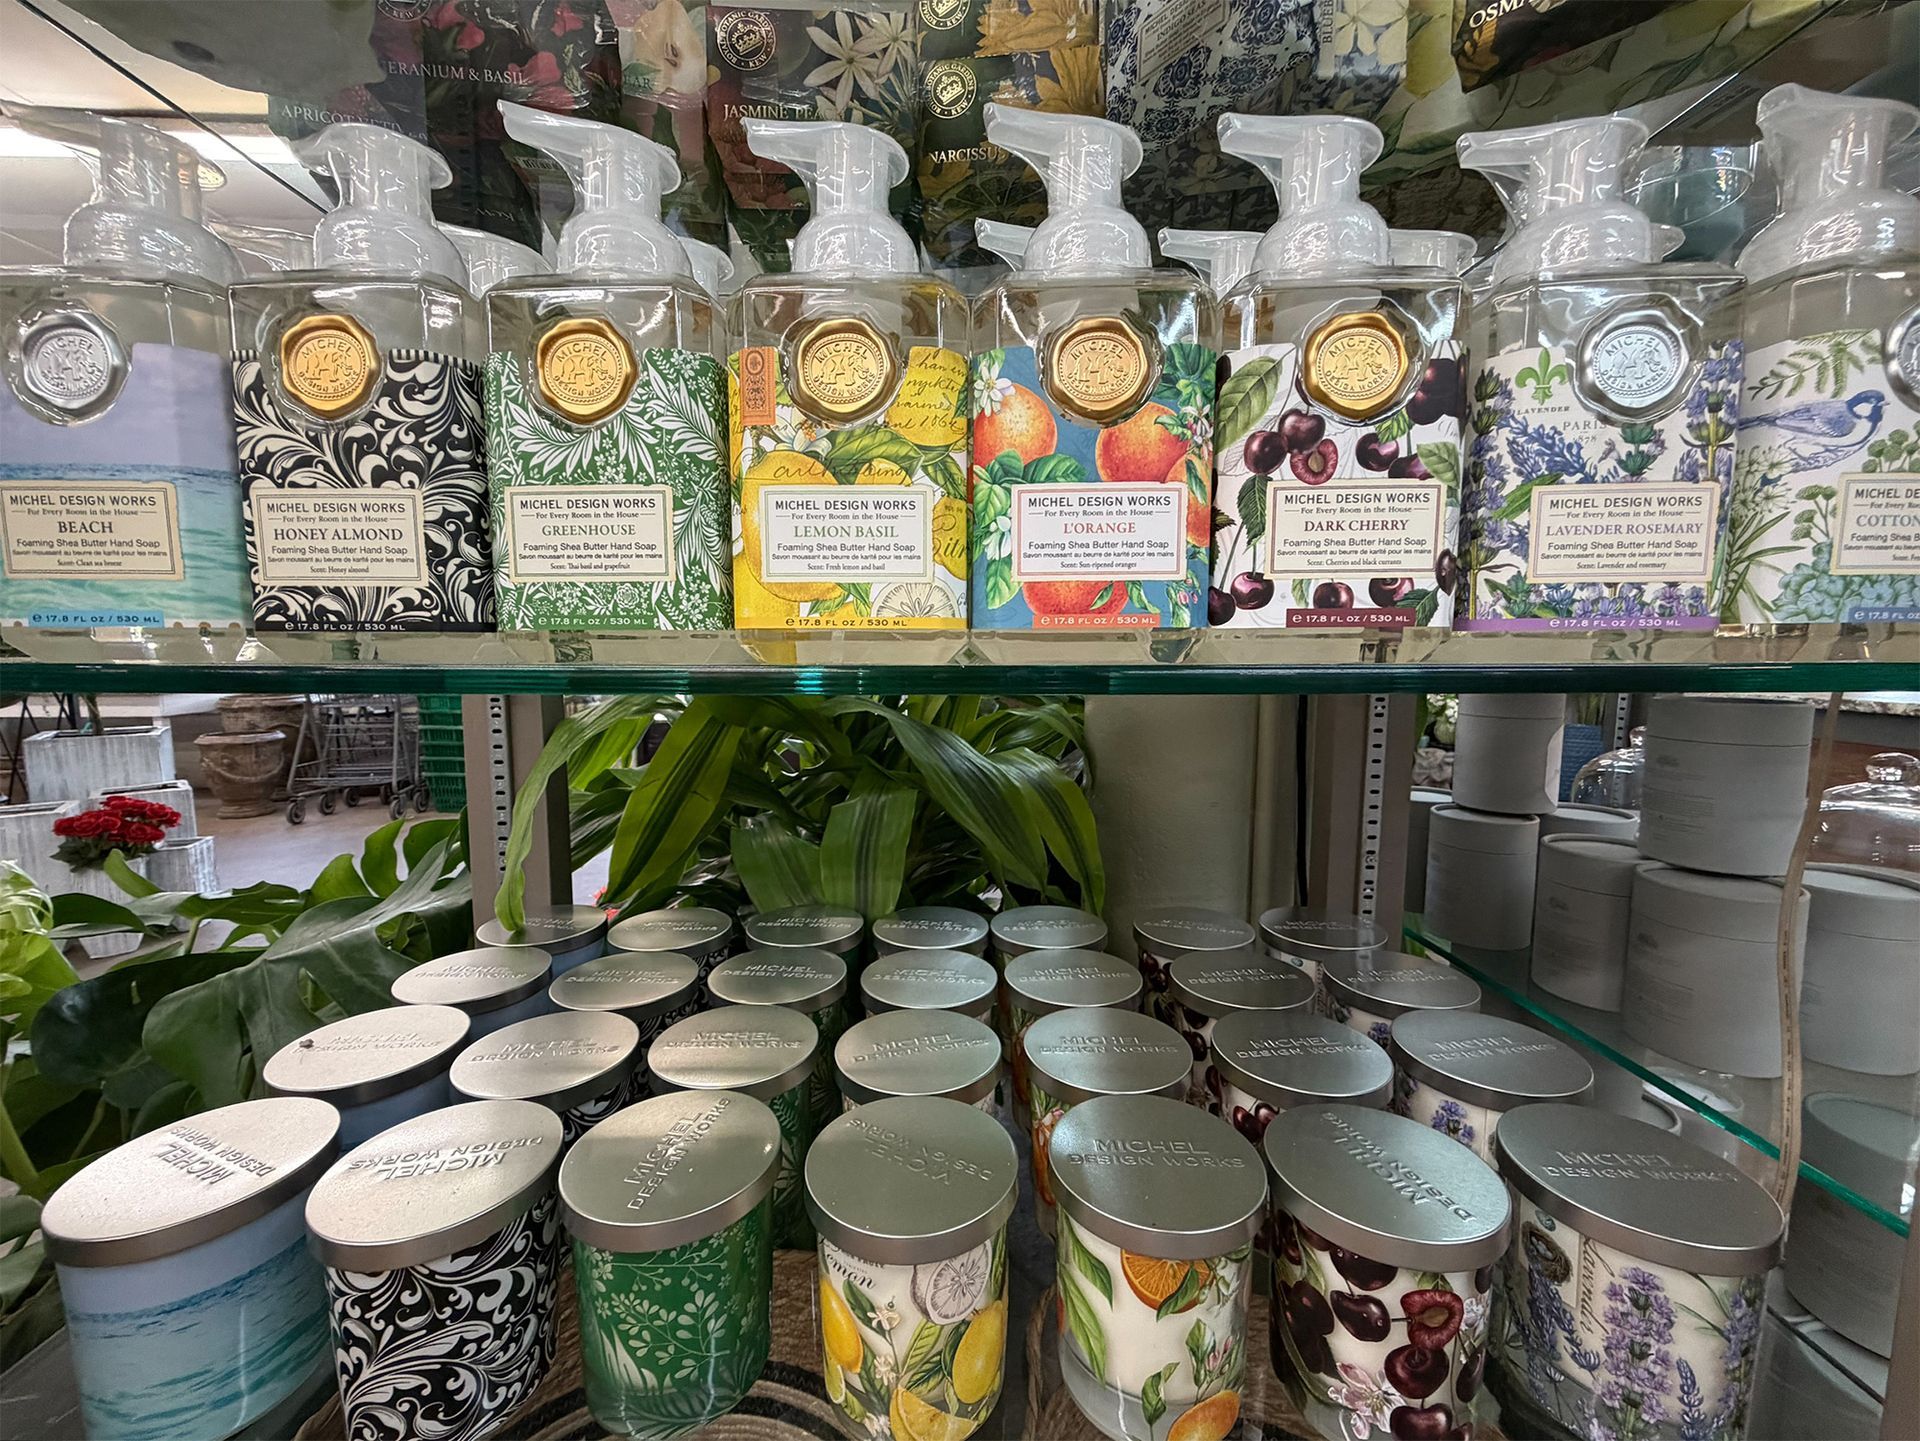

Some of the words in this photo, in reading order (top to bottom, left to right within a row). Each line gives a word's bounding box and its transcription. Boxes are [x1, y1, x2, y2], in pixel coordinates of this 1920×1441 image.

[749, 53, 768, 68] KEW
[468, 67, 480, 81] &
[484, 70, 531, 85] BASIL
[723, 104, 789, 121] JASMINE
[951, 100, 969, 115] KEW
[301, 339, 353, 360] MICHEL
[556, 343, 607, 362] MICHEL
[815, 343, 868, 363] MICHEL
[1517, 406, 1570, 415] LAVENDER
[1285, 494, 1330, 504] MICHEL
[1336, 494, 1381, 503] DESIGN
[1386, 493, 1430, 502] WORKS
[1855, 488, 1900, 498] MICHEL
[10, 495, 55, 505] MICHEL
[60, 496, 105, 505] DESIGN
[111, 496, 156, 506] WORKS
[520, 500, 562, 509] MICHEL
[567, 499, 608, 509] DESIGN
[613, 498, 655, 508] WORKS
[776, 500, 820, 510] MICHEL
[825, 500, 868, 510] DESIGN
[873, 500, 916, 510] WORKS
[1029, 497, 1073, 507] MICHEL
[1079, 497, 1122, 506] DESIGN
[1127, 496, 1170, 506] WORKS
[1550, 498, 1598, 509] MICHEL
[1604, 497, 1652, 508] DESIGN
[1657, 496, 1702, 506] WORKS
[267, 503, 309, 512] MICHEL
[314, 503, 356, 512] DESIGN
[361, 503, 405, 512] WORKS
[297, 516, 316, 524] Every
[1304, 520, 1345, 531] DARK
[1349, 520, 1408, 531] CHERRY
[1856, 515, 1920, 526] COTTON
[58, 521, 113, 533] BEACH
[542, 525, 636, 536] GREENHOUSE
[794, 526, 850, 537] LEMON
[856, 526, 898, 537] BASIL
[1064, 522, 1136, 534] L'ORANGE
[1546, 524, 1622, 536] LAVENDER
[1626, 523, 1703, 534] ROSEMARY
[274, 528, 328, 540] HONEY
[332, 528, 402, 540] ALMOND
[524, 543, 558, 552] Foaming
[583, 542, 608, 550] Butter
[610, 542, 632, 550] Hand
[634, 542, 656, 551] Soap
[778, 543, 813, 553] Foaming
[816, 543, 838, 551] Shea
[840, 543, 865, 551] Butter
[868, 543, 890, 551] Hand
[893, 543, 915, 552] Soap
[1029, 541, 1066, 551] Foaming
[1068, 541, 1090, 549] Shea
[1147, 540, 1169, 550] Soap
[1284, 539, 1321, 548] Foaming
[1324, 538, 1346, 546] Shea
[1349, 538, 1376, 546] Butter
[1378, 538, 1401, 546] Hand
[1404, 537, 1427, 547] Soap
[272, 546, 306, 556] Foaming
[308, 546, 330, 554] Shea
[332, 546, 357, 554] Butter
[360, 546, 382, 554] Hand
[385, 546, 408, 556] Soap
[1250, 1037, 1339, 1048] MICHEL
[1236, 1048, 1304, 1058] DESIGN
[171, 1126, 220, 1151] WORKS
[452, 1137, 544, 1156] DESIGN
[624, 1113, 703, 1184] MICHEL
[1093, 1139, 1210, 1154] MICHEL
[627, 1148, 688, 1209] DESIGN
[685, 1097, 731, 1143] WORKS
[154, 1142, 235, 1184] MICHEL
[215, 1147, 276, 1177] DESIGN
[350, 1150, 440, 1170] WORKS
[377, 1152, 506, 1180] MICHEL
[1068, 1154, 1154, 1166] DESIGN
[1162, 1156, 1245, 1168] WORKS
[1541, 1166, 1640, 1179] DESIGN
[1390, 1160, 1477, 1222] DESIGN
